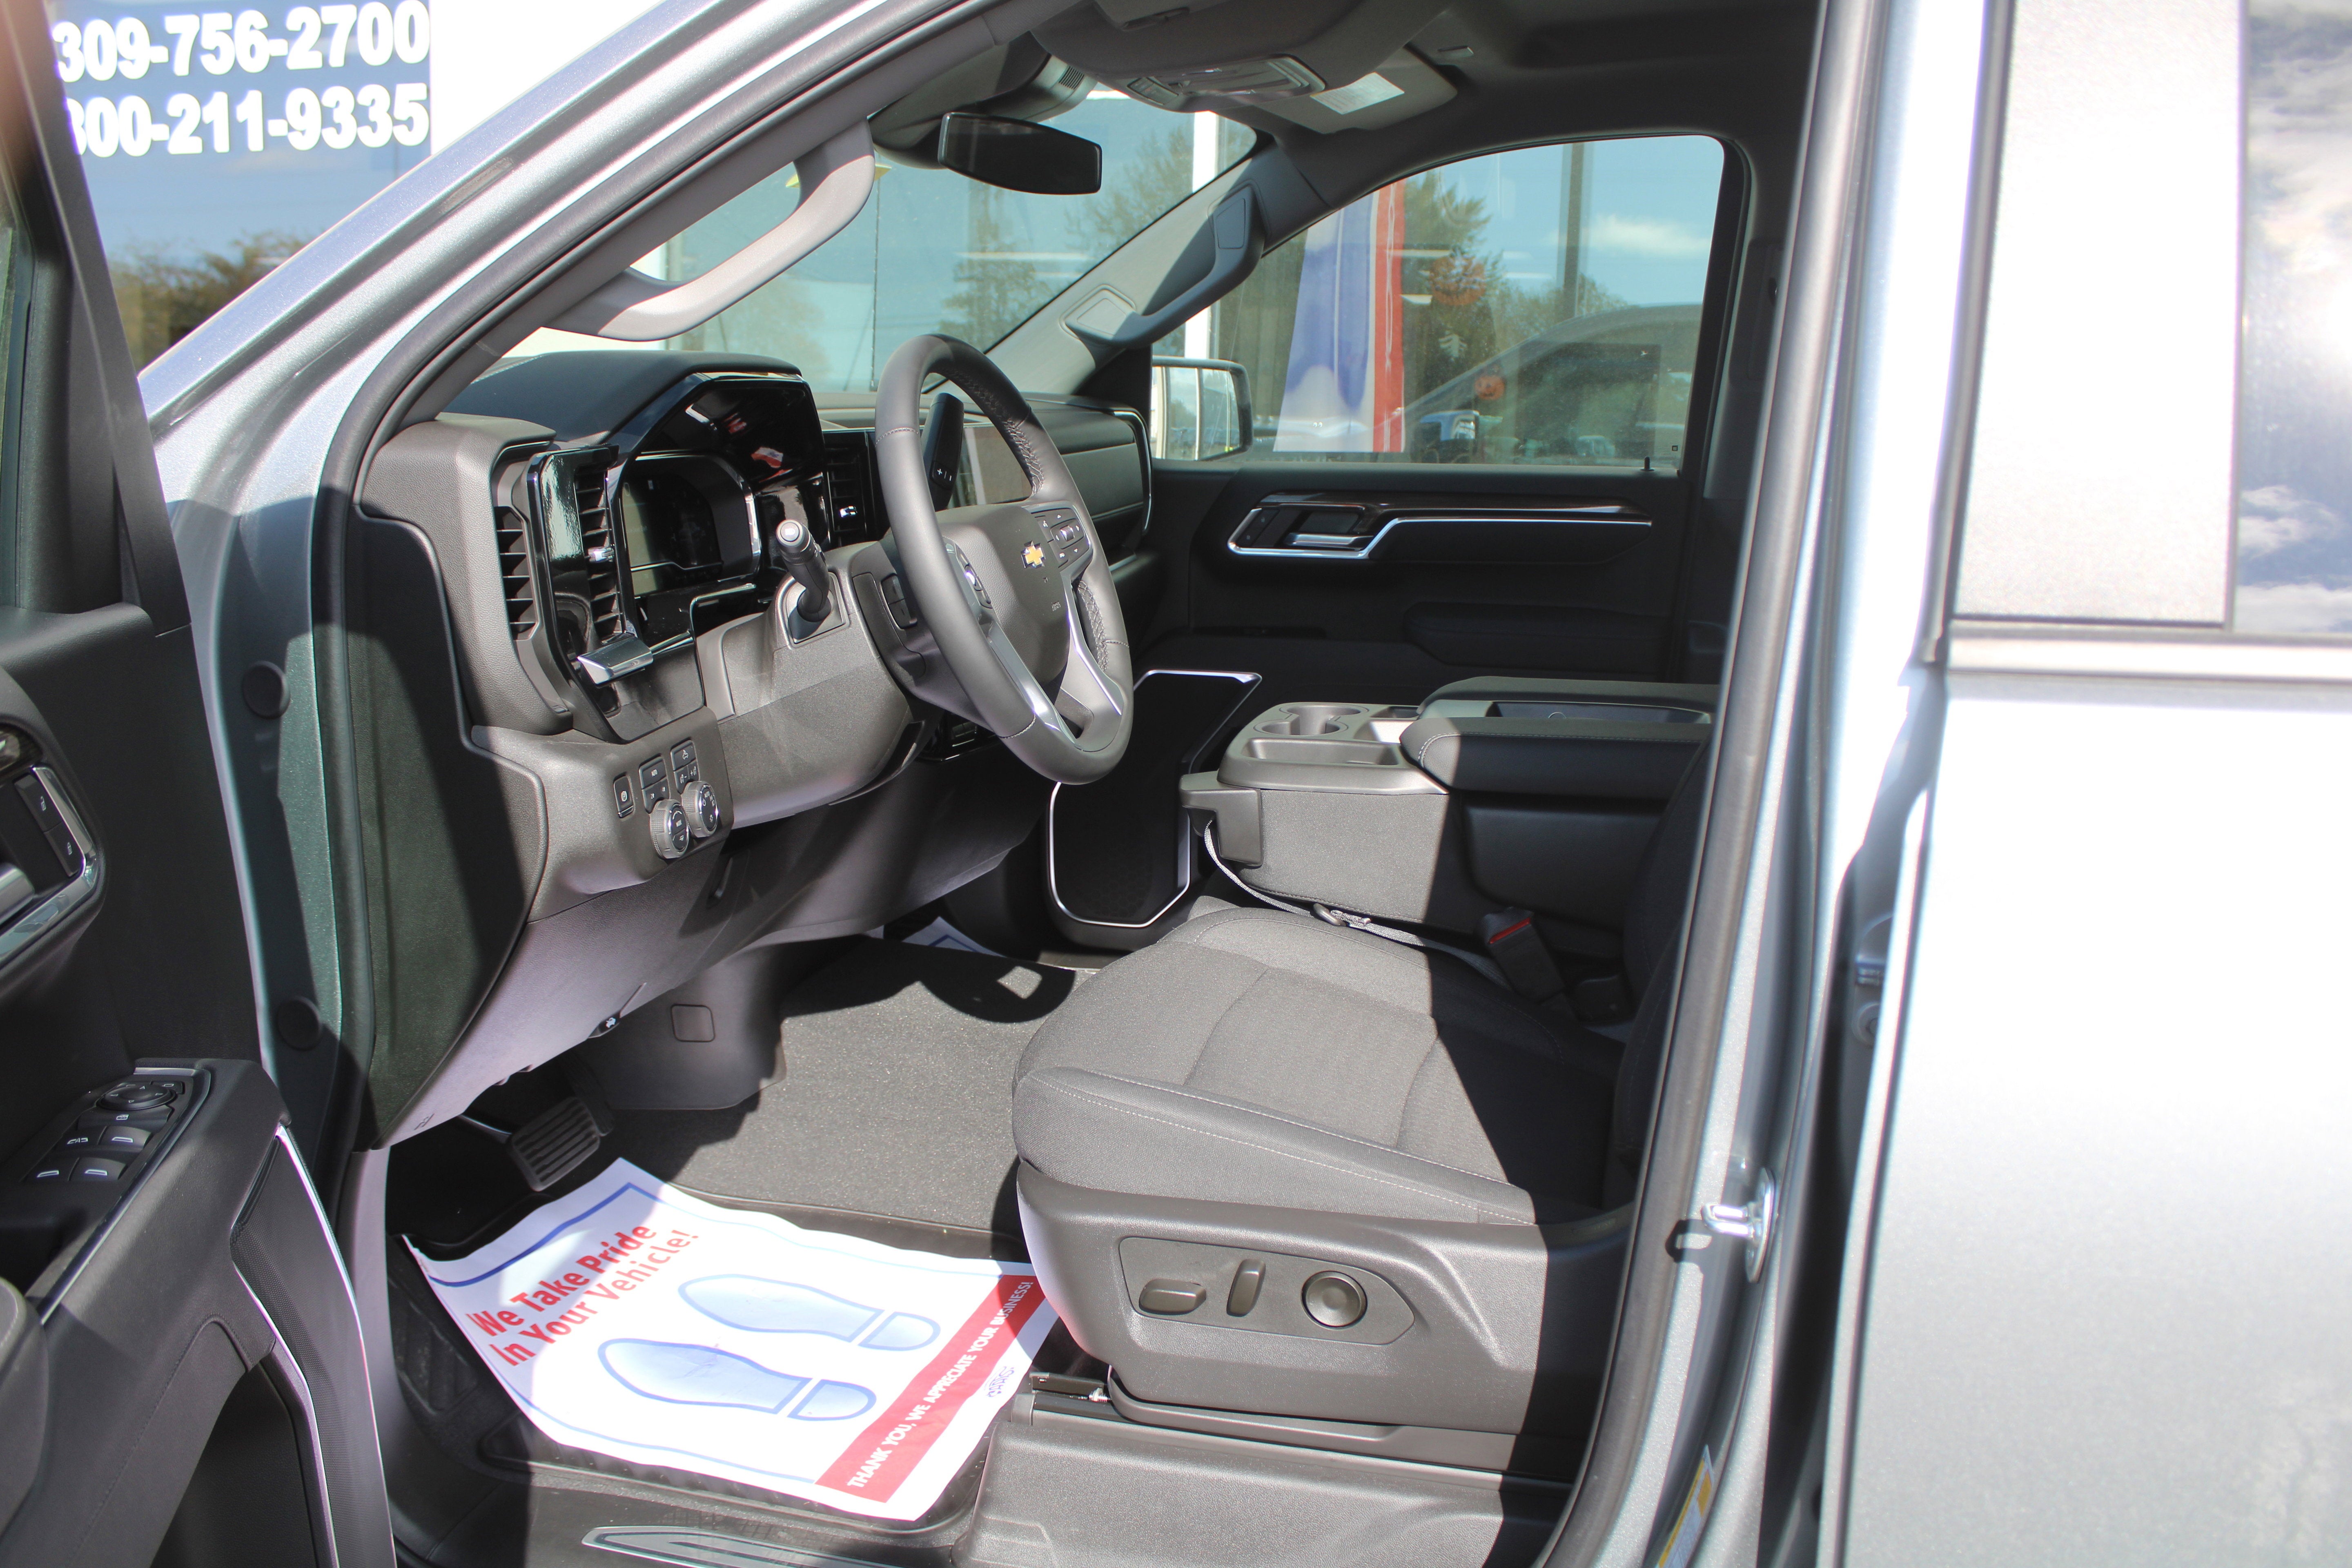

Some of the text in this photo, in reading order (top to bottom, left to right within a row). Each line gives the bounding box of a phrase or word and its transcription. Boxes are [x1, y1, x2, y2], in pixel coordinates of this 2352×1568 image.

[52, 0, 430, 82] 309-756-2700
[466, 1226, 657, 1336] We Take Pride
[488, 1229, 699, 1366] In Your Vehicle!
[846, 1282, 1033, 1488] THANK YOU, WE APPRECIATE YOUR BUSINESS!
